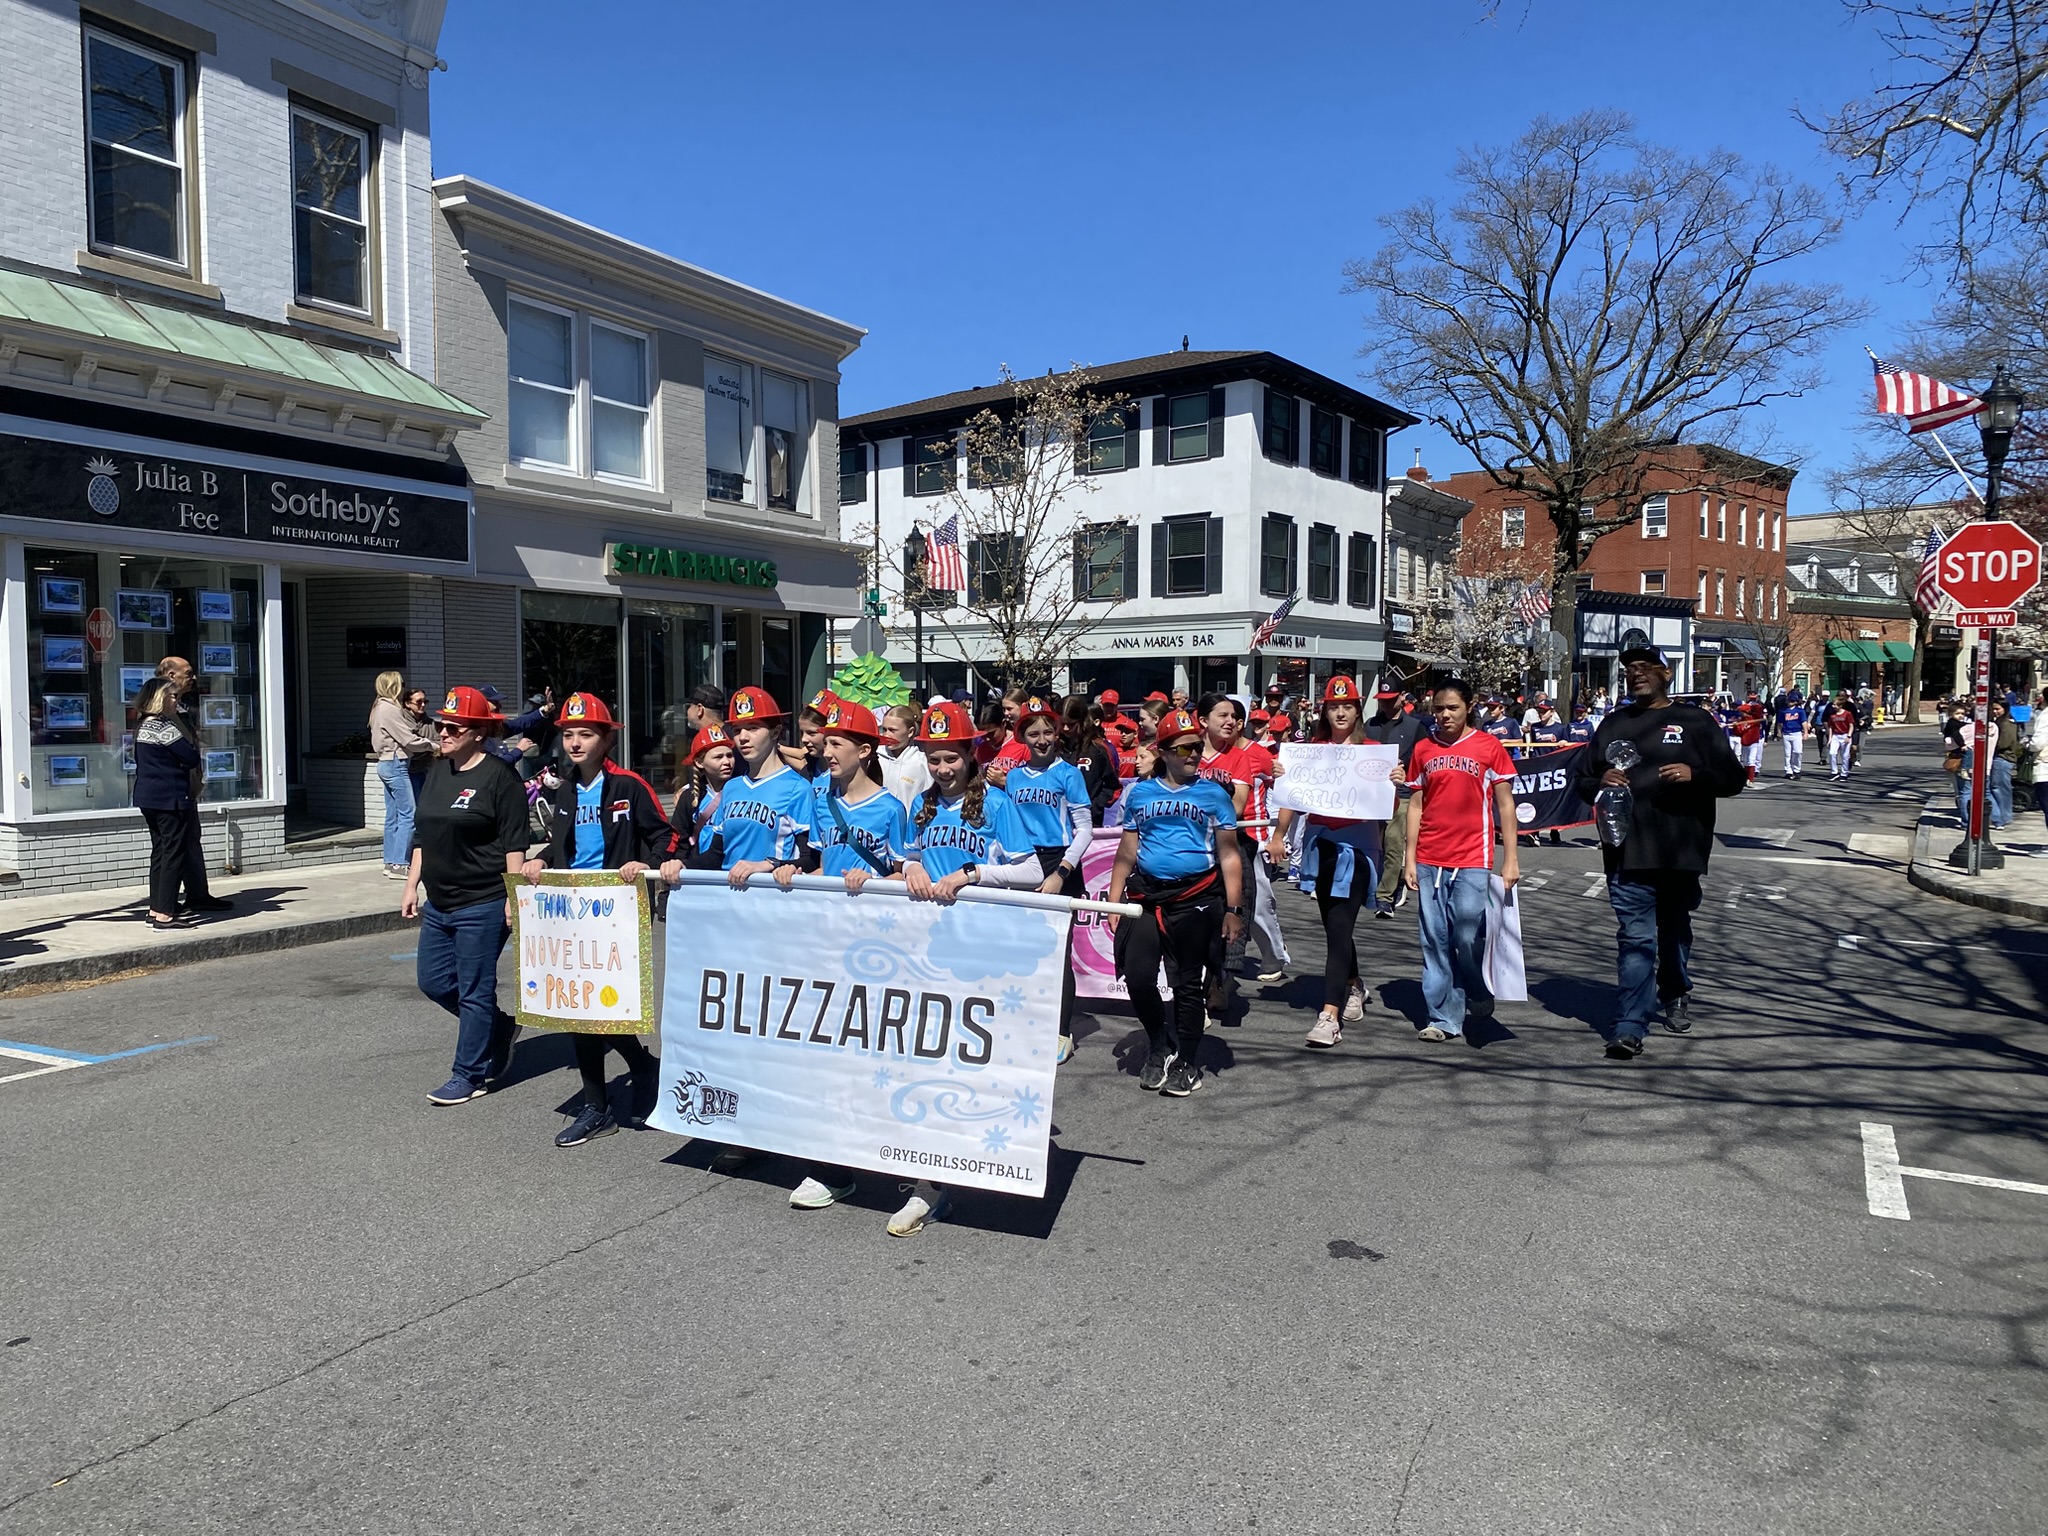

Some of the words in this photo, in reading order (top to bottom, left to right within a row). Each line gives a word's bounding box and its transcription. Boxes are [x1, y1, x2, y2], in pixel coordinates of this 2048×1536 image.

[134, 461, 193, 493] Julia
[201, 470, 219, 496] B
[178, 503, 220, 531] Fee
[271, 481, 400, 533] Sotheby's
[272, 525, 361, 546] INTERNATIONAL
[363, 536, 400, 549] REALTY
[613, 542, 778, 588] STARBUCKS
[1944, 549, 2034, 584] STOP
[1960, 614, 1982, 625] ALL
[1987, 613, 2011, 624] WAY
[1111, 637, 1140, 649] ANNA
[1143, 635, 1184, 648] MARIA'S
[1192, 634, 1215, 647] BAR
[1295, 636, 1306, 648] BAR
[1285, 746, 1324, 760] THANK
[1334, 747, 1357, 761] YOU
[1289, 763, 1347, 785] COLONY
[1511, 768, 1567, 795] AVES
[1010, 787, 1058, 809] IZZARDS
[723, 800, 778, 831] IZZARDS
[919, 824, 986, 859] LIZZARDS
[534, 892, 576, 921] THANK
[577, 897, 615, 920] YOU
[525, 935, 623, 972] NOVELLA
[545, 973, 595, 1010] PREP
[698, 967, 996, 1067] BLIZZARDS
[699, 1086, 739, 1117] RYE
[879, 1145, 1033, 1181] @RYEGIRLSSOFTBALL
